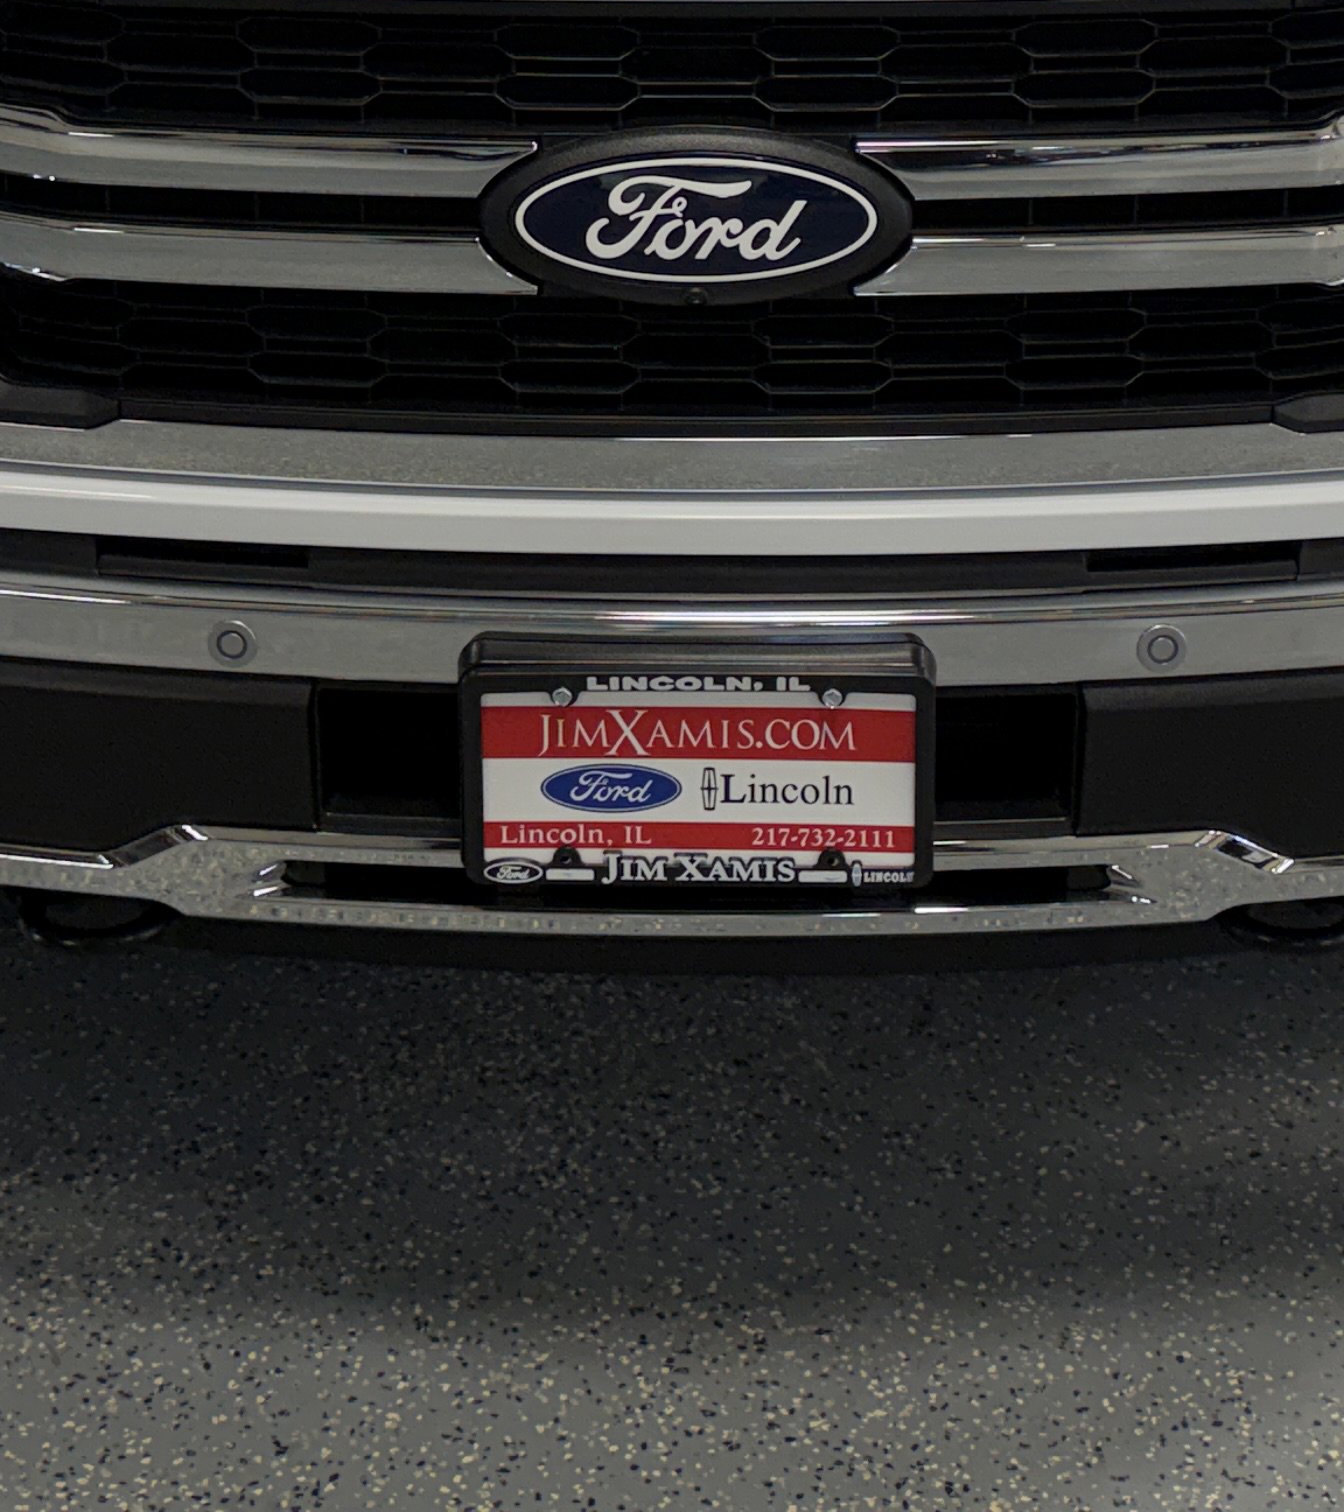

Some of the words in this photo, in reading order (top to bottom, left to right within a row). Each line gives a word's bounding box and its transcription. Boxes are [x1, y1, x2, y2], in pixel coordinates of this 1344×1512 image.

[585, 175, 808, 262] Ford
[775, 677, 811, 692] IL
[537, 709, 856, 756] JIMXAMIS.COM
[569, 769, 652, 804] Ford
[720, 773, 855, 806] Lincoln
[500, 823, 614, 847] Lincoln,
[624, 824, 652, 846] IL
[752, 827, 896, 848] 217-732-2111
[497, 865, 530, 879] Ford
[601, 853, 668, 884] JIM
[674, 855, 796, 883] XAMIS
[863, 871, 915, 883] LINCOLN
